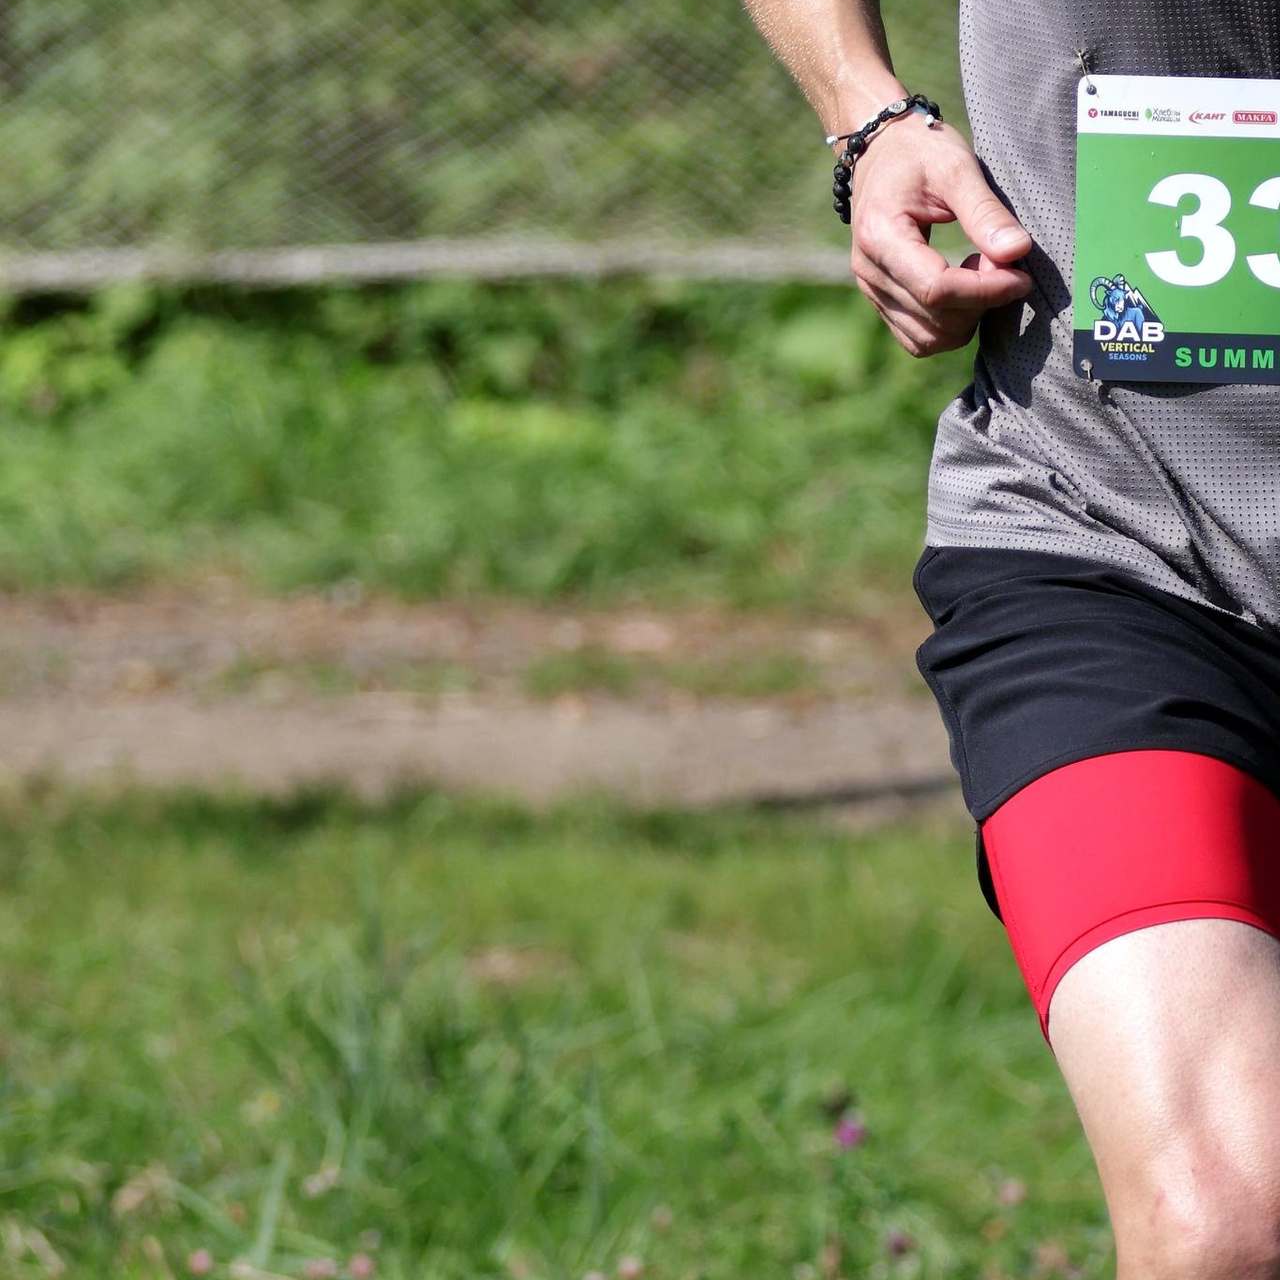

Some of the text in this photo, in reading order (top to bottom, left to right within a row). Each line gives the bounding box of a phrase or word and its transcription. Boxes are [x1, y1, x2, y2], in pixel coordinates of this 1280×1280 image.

[1094, 320, 1165, 342] DAB
[1101, 342, 1155, 353] VERTICAL
[1109, 353, 1147, 361] SEASONS
